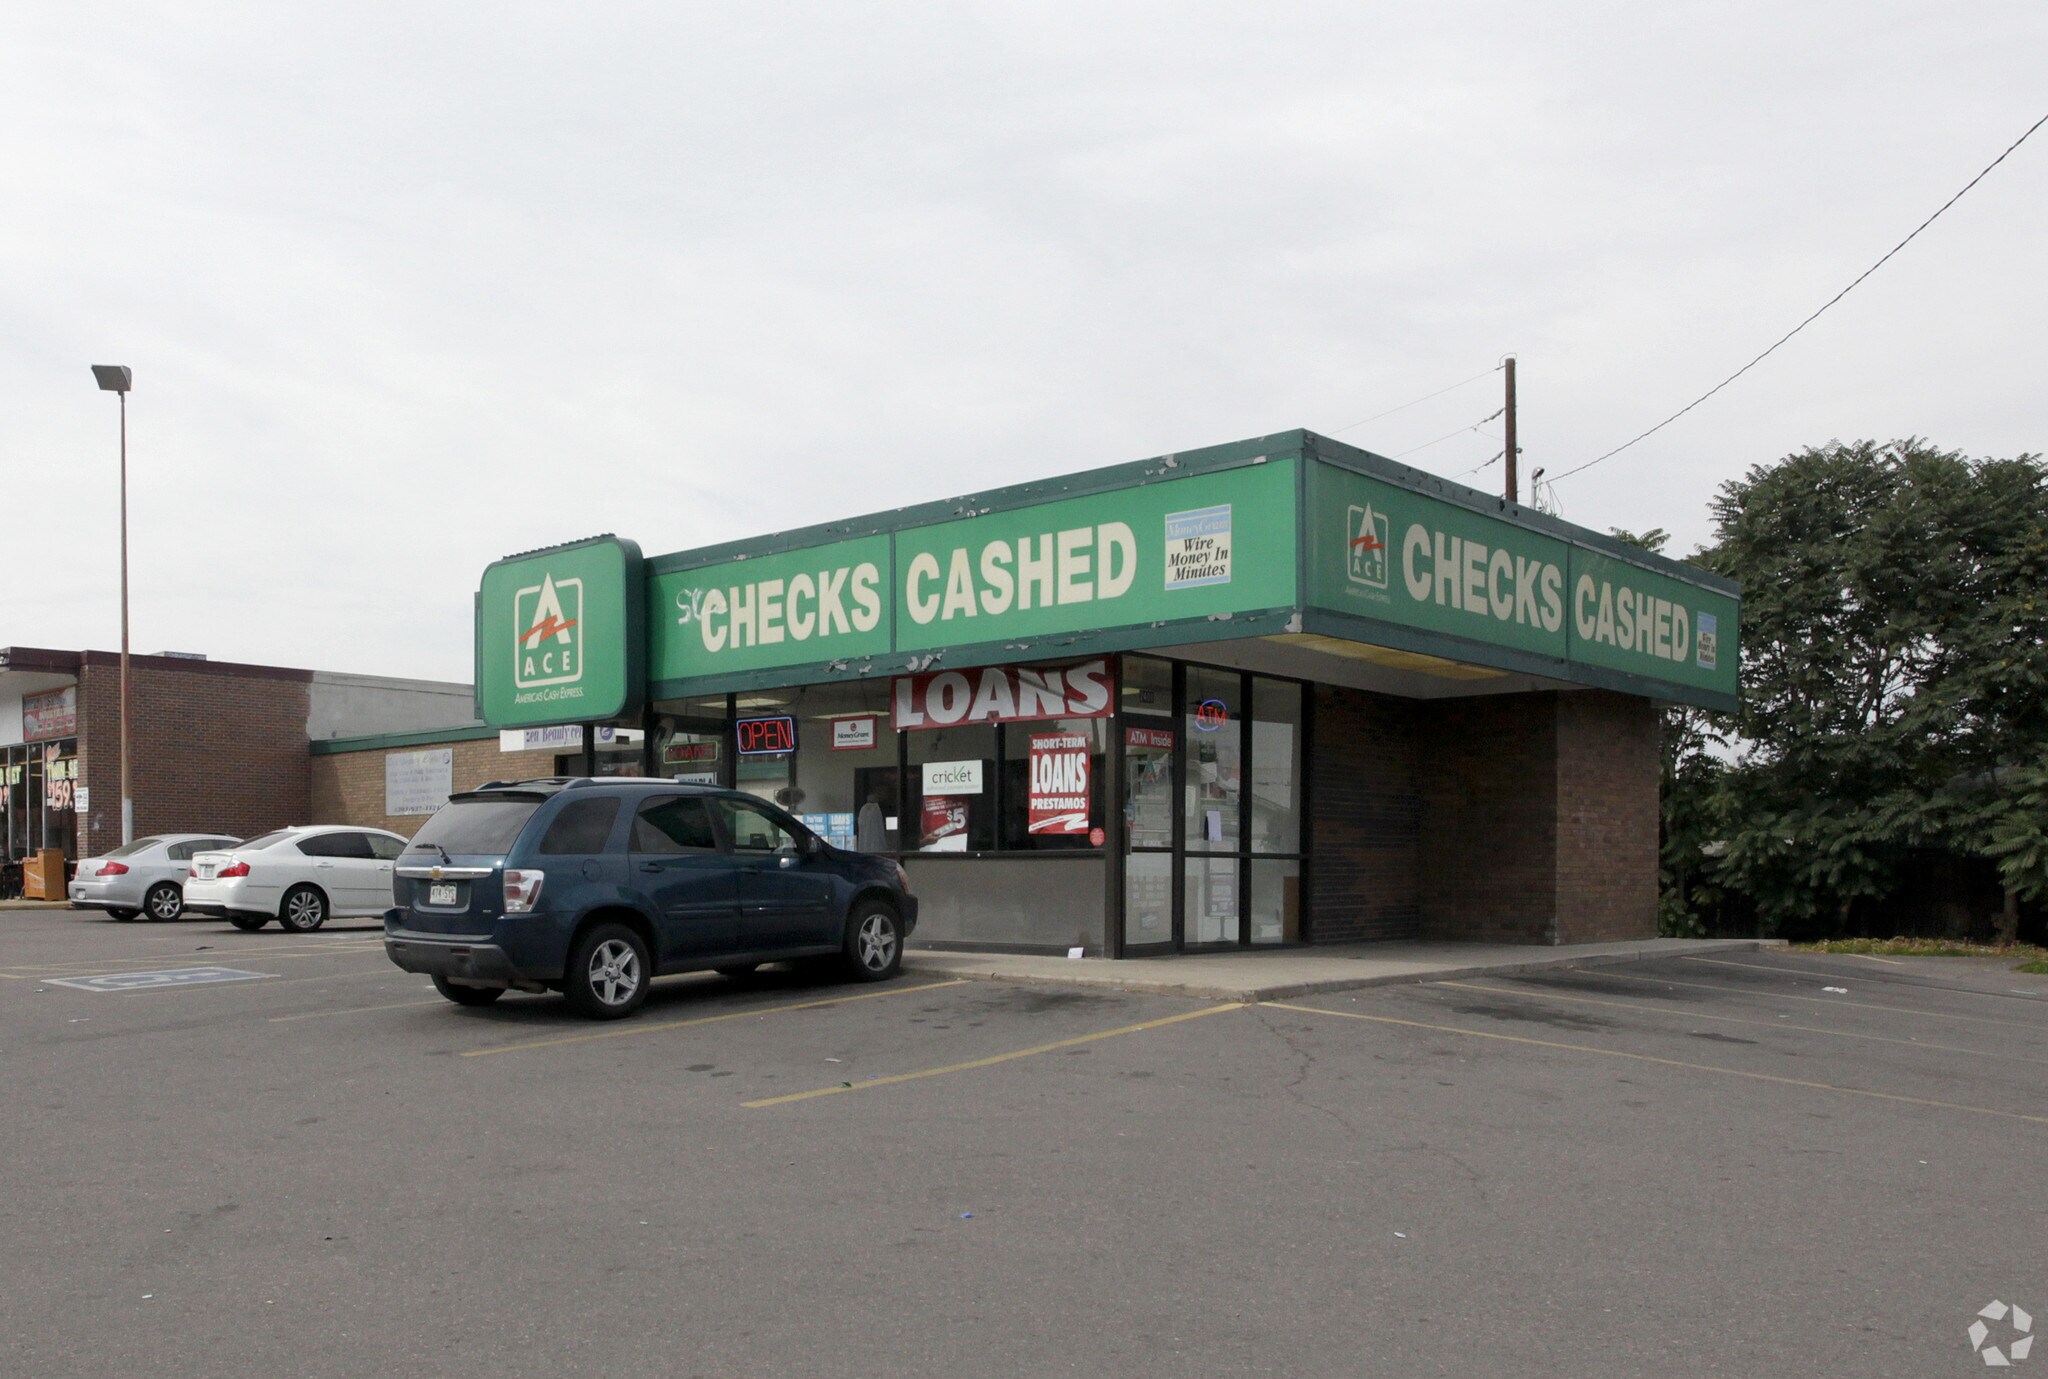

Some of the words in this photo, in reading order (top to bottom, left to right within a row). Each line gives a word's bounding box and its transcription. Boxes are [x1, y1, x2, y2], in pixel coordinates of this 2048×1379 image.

[1184, 536, 1214, 552] Wire
[1168, 551, 1211, 567] Money
[1214, 546, 1228, 561] In
[906, 521, 1137, 625] CASHED
[1173, 564, 1226, 581] Minutes
[1402, 523, 1562, 632] CHECKS
[701, 562, 880, 653] CHECKS
[1575, 573, 1690, 663] CASHED
[895, 660, 1110, 729] LOANS
[1197, 705, 1227, 727] ATM
[739, 720, 792, 751] OPEN
[1032, 736, 1087, 750] SHORT-TERM
[1130, 731, 1148, 745] ATM
[1150, 732, 1172, 748] Inside
[932, 765, 973, 784] cricket
[1031, 752, 1087, 794] LOANS
[1031, 797, 1086, 810] PRESTAMOS
[946, 807, 966, 829] $5
